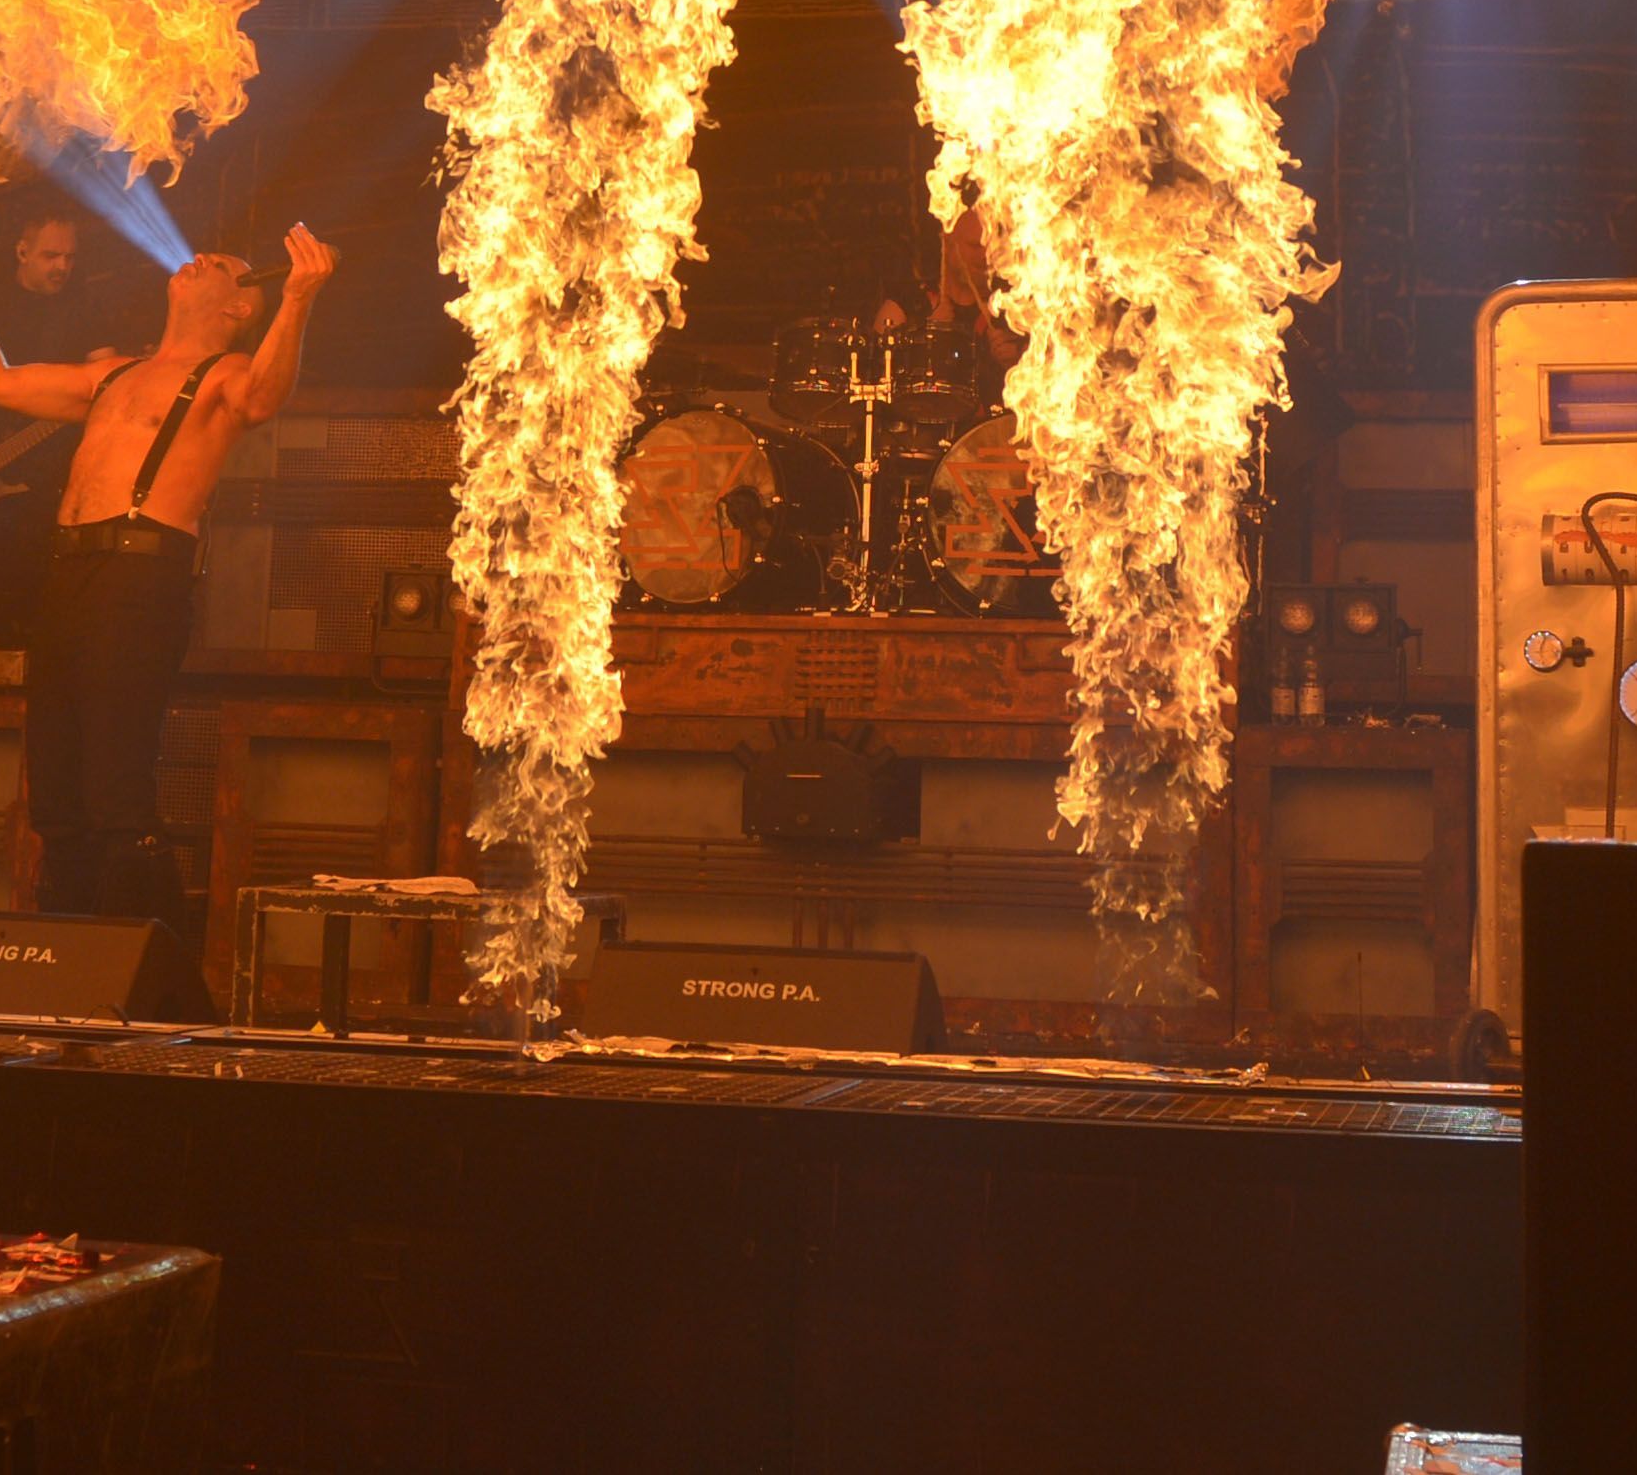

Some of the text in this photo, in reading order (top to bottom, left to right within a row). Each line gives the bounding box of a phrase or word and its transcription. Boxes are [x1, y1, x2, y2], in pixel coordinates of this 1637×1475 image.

[23, 947, 57, 963] P.A.
[682, 980, 820, 1001] STRONG P.A.
